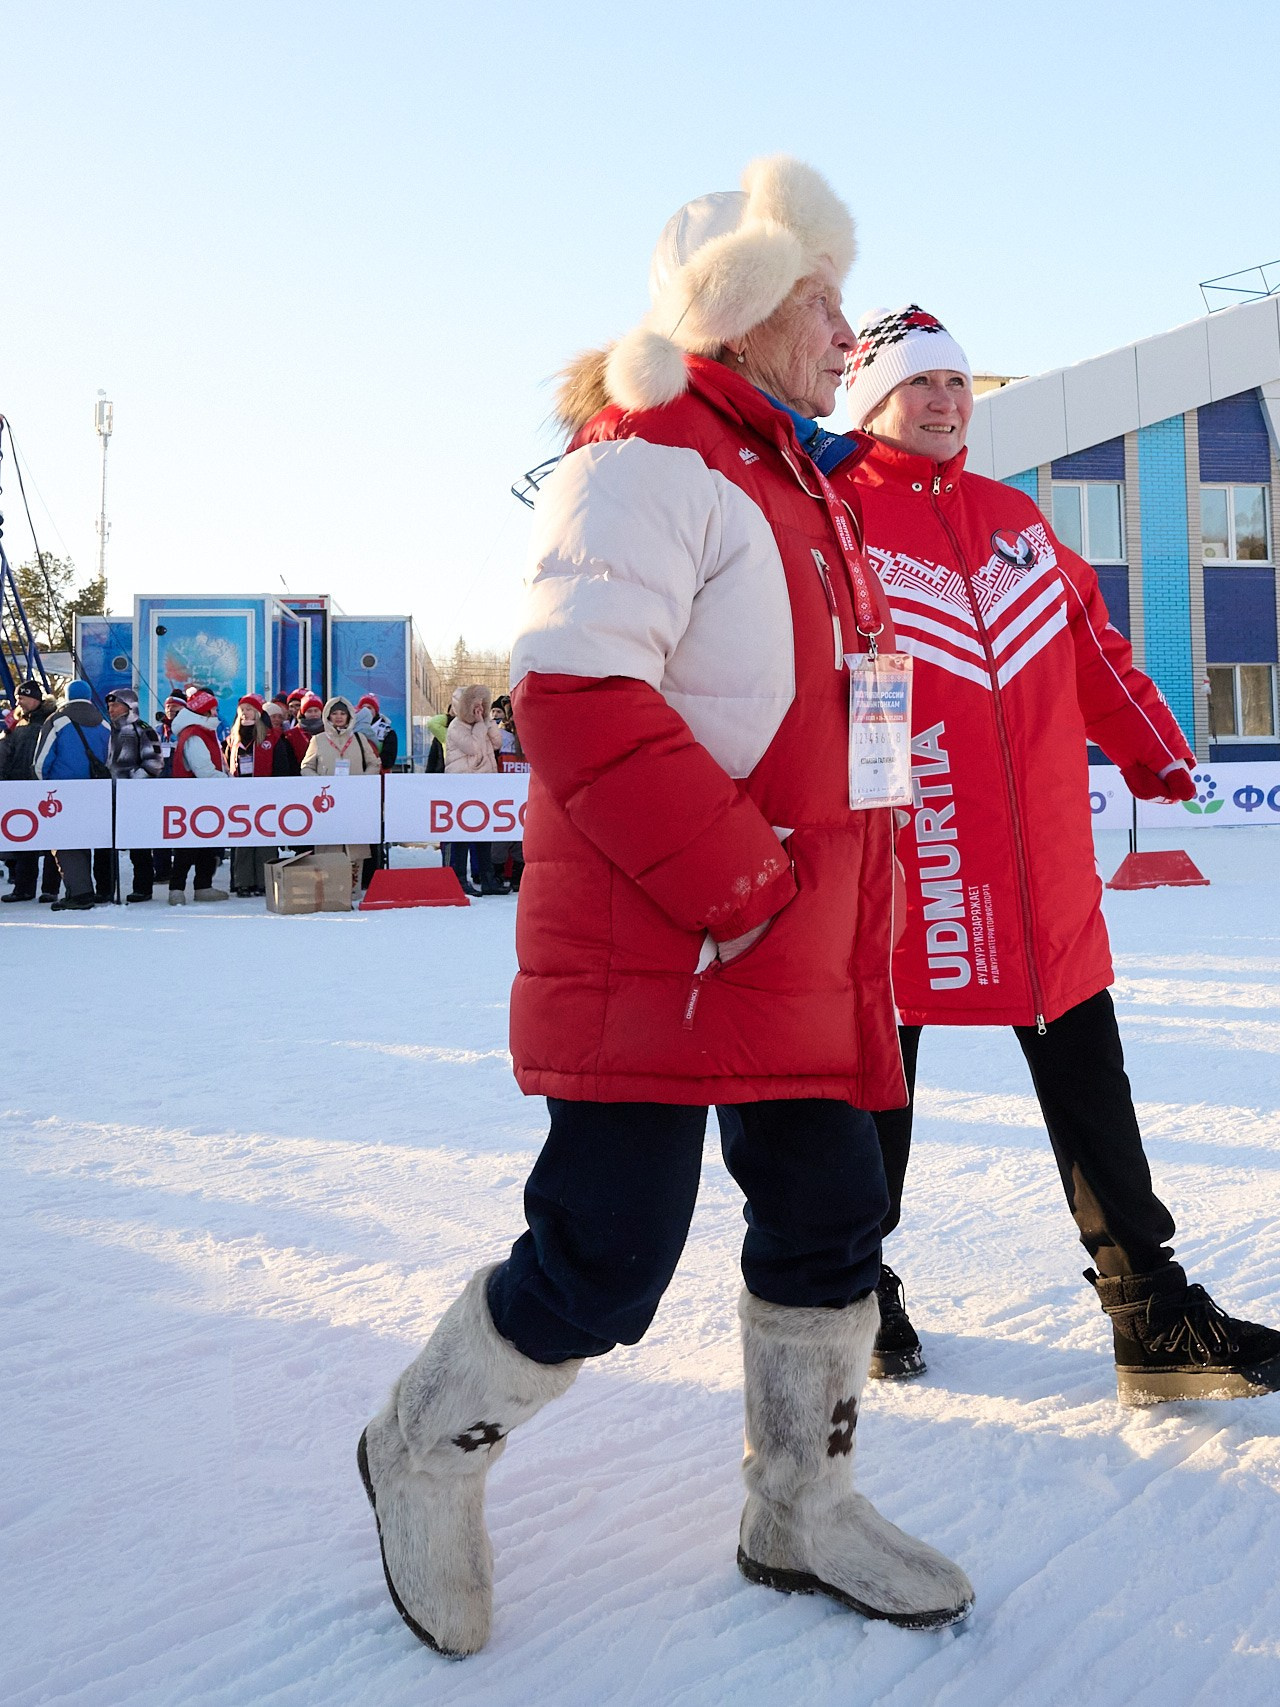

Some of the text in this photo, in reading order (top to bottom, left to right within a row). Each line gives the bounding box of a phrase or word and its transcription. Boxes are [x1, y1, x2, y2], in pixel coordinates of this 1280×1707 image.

[880, 691, 905, 699] РОССИИ
[162, 803, 313, 839] BOSCO
[911, 720, 972, 990] UDMURTIA
[969, 885, 989, 986] #УДМУРТИЯЗАРЯЖАЕТ
[983, 883, 1000, 985] #УДМУРТИЯТЕРРИТОРИЯСПОРТА
